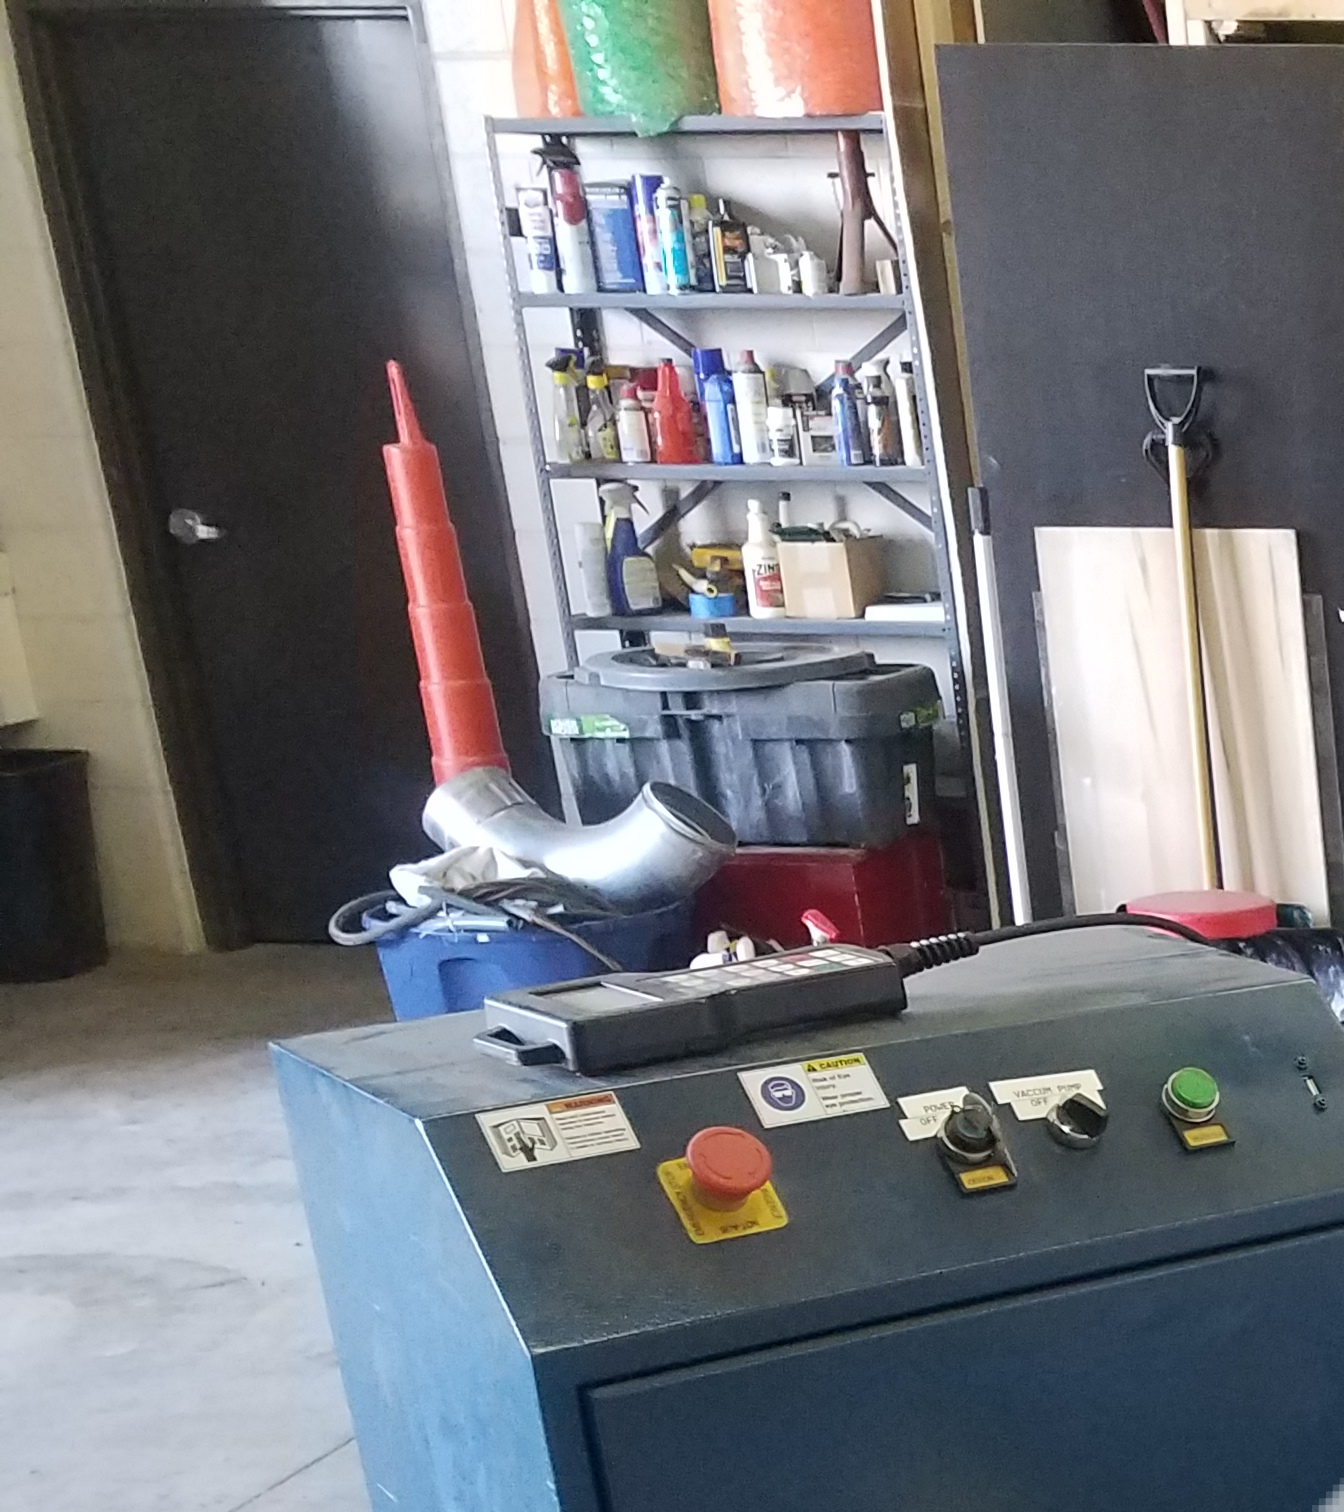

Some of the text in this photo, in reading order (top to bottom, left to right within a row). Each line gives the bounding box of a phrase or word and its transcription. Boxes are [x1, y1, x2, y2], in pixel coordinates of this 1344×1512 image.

[819, 1057, 861, 1070] CAUTION
[1057, 1083, 1082, 1092] PUMP
[923, 1101, 955, 1113] POWER
[1031, 1098, 1048, 1107] OFF
[920, 1116, 938, 1126] OFF
